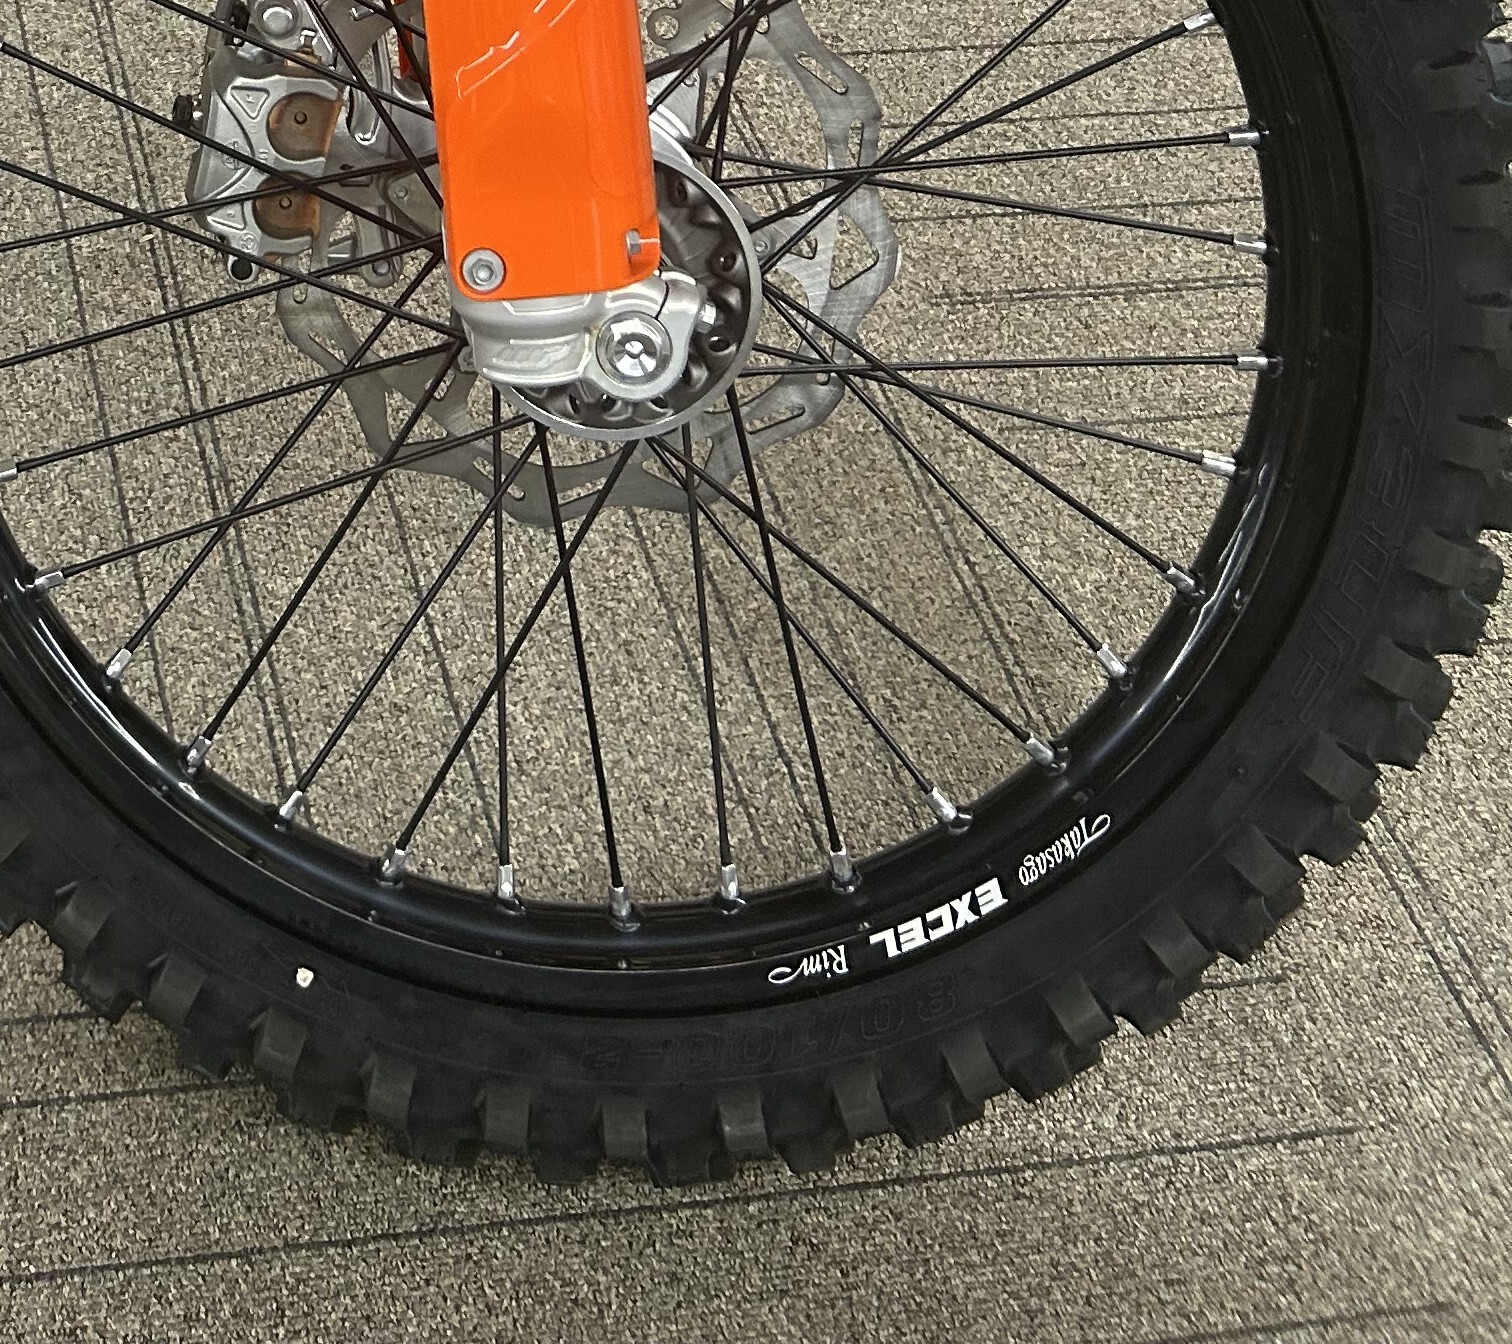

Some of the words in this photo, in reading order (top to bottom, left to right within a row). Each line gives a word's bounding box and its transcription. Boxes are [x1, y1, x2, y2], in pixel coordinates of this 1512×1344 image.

[1018, 813, 1111, 887] Takasago
[868, 877, 1009, 960] EXCEL
[767, 944, 850, 985] Rim
